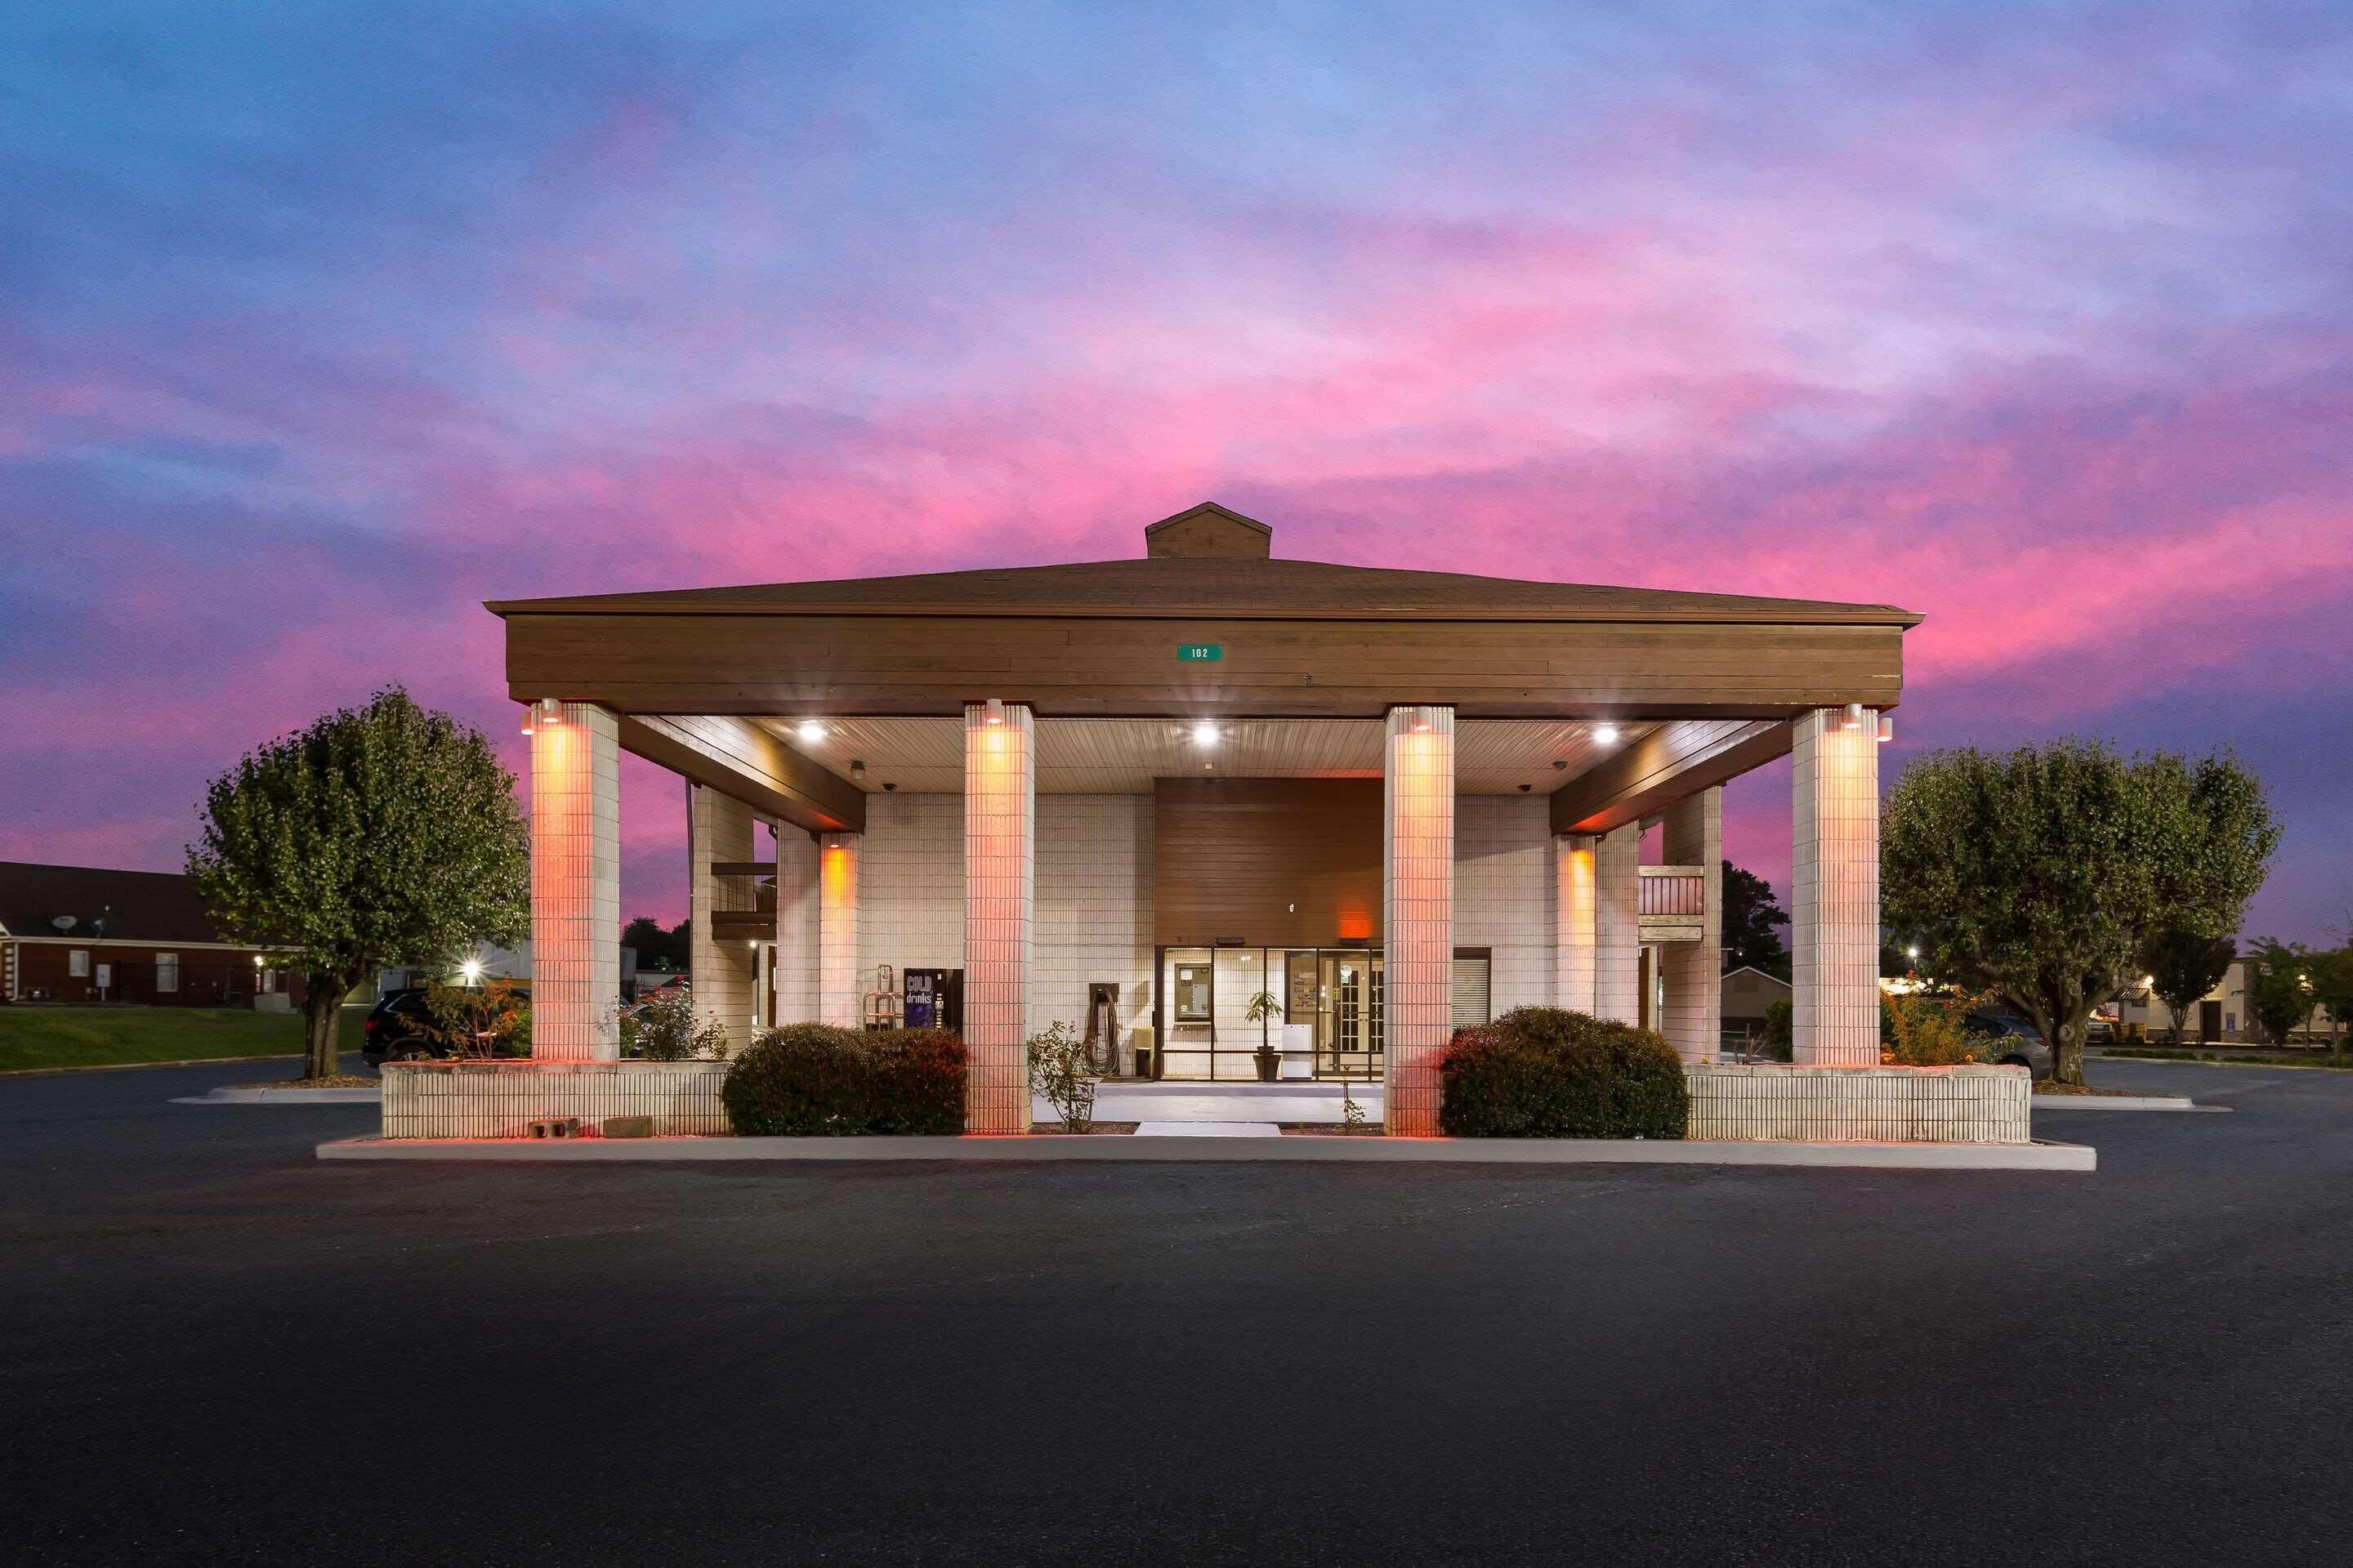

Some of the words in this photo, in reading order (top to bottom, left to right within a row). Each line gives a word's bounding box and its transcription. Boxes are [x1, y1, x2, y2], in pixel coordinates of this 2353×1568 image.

[1192, 649, 1208, 658] 102
[907, 976, 932, 991] COLD
[907, 992, 931, 1003] drinks
